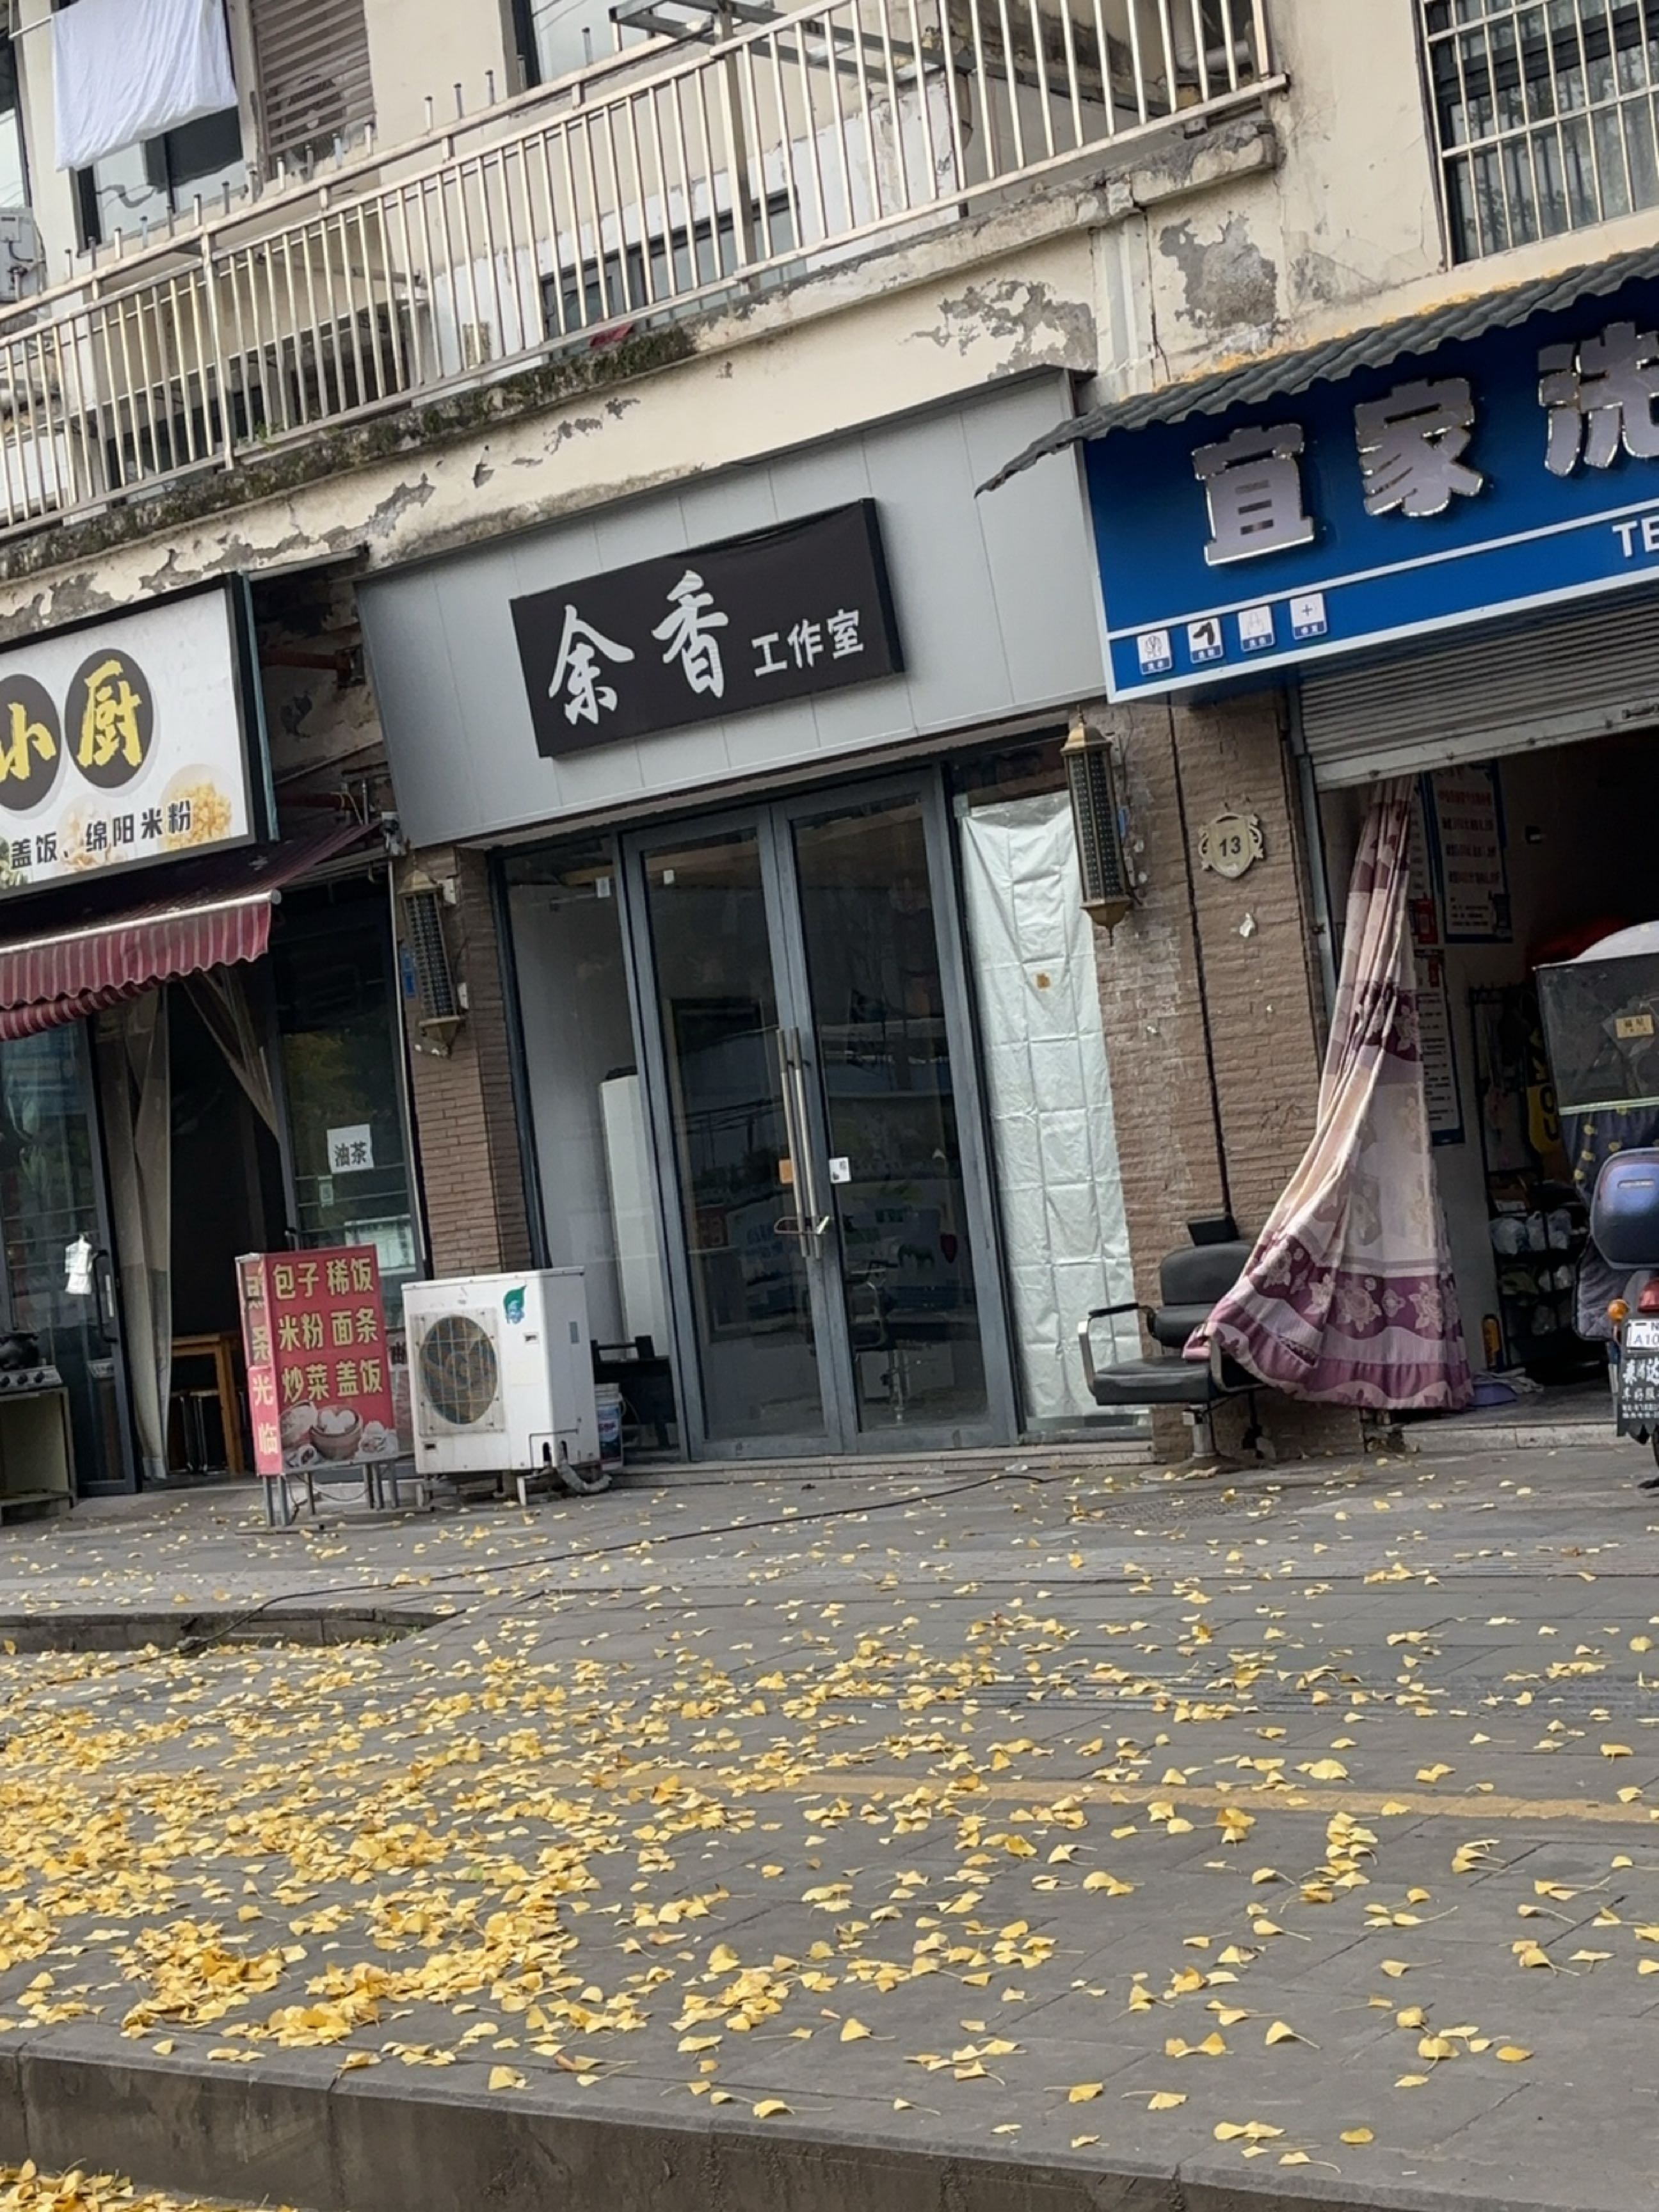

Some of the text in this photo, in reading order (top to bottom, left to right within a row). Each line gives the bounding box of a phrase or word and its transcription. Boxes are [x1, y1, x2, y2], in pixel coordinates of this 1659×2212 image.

[548, 570, 865, 725] 余香 工作室
[0, 660, 143, 781] 小厨
[1219, 835, 1241, 857] 13
[335, 1141, 367, 1167] 油茶
[273, 1257, 374, 1300] 包子 稀饭
[278, 1308, 379, 1352] 米粉 面条
[281, 1358, 383, 1403] 炒菜 盖饭
[253, 1374, 278, 1455] 光临
